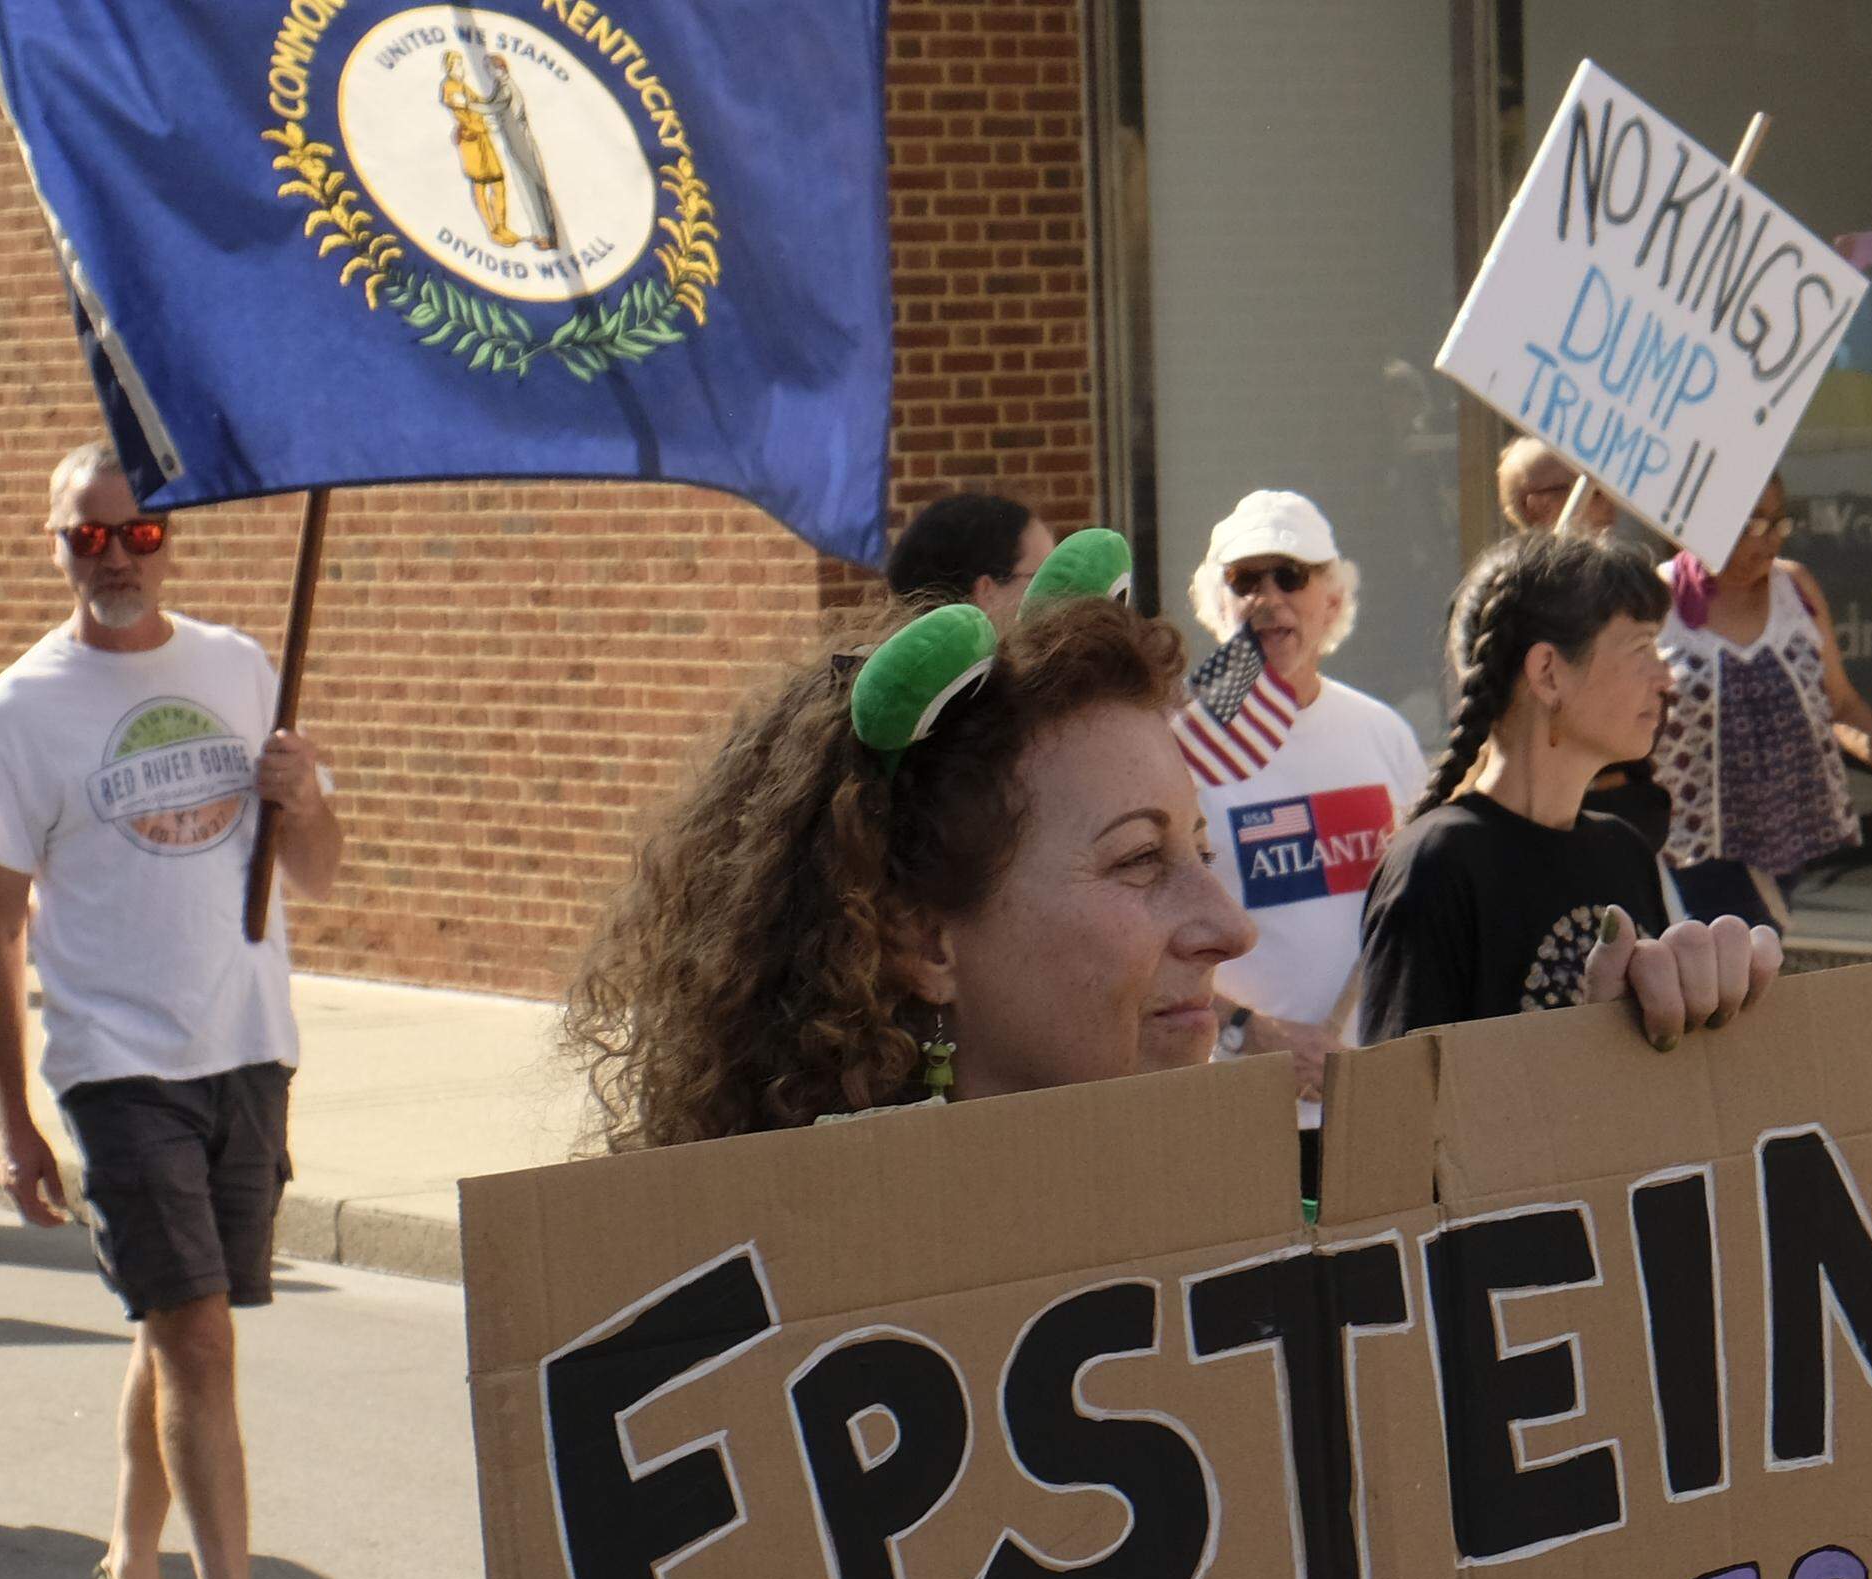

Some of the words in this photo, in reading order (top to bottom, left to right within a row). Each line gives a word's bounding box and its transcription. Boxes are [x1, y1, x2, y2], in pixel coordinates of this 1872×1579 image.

[375, 25, 447, 72] UNITED
[456, 25, 487, 46] WE
[496, 33, 570, 83] STAND
[434, 226, 529, 280] DIVIDED
[535, 262, 566, 281] WE
[569, 238, 616, 271] FALL
[1557, 98, 1652, 247] NO
[1635, 146, 1854, 426] KINGS!
[1559, 264, 1719, 432] DUMP
[100, 768, 135, 806] RED
[141, 751, 193, 788] RIVER
[1242, 810, 1270, 825] USA
